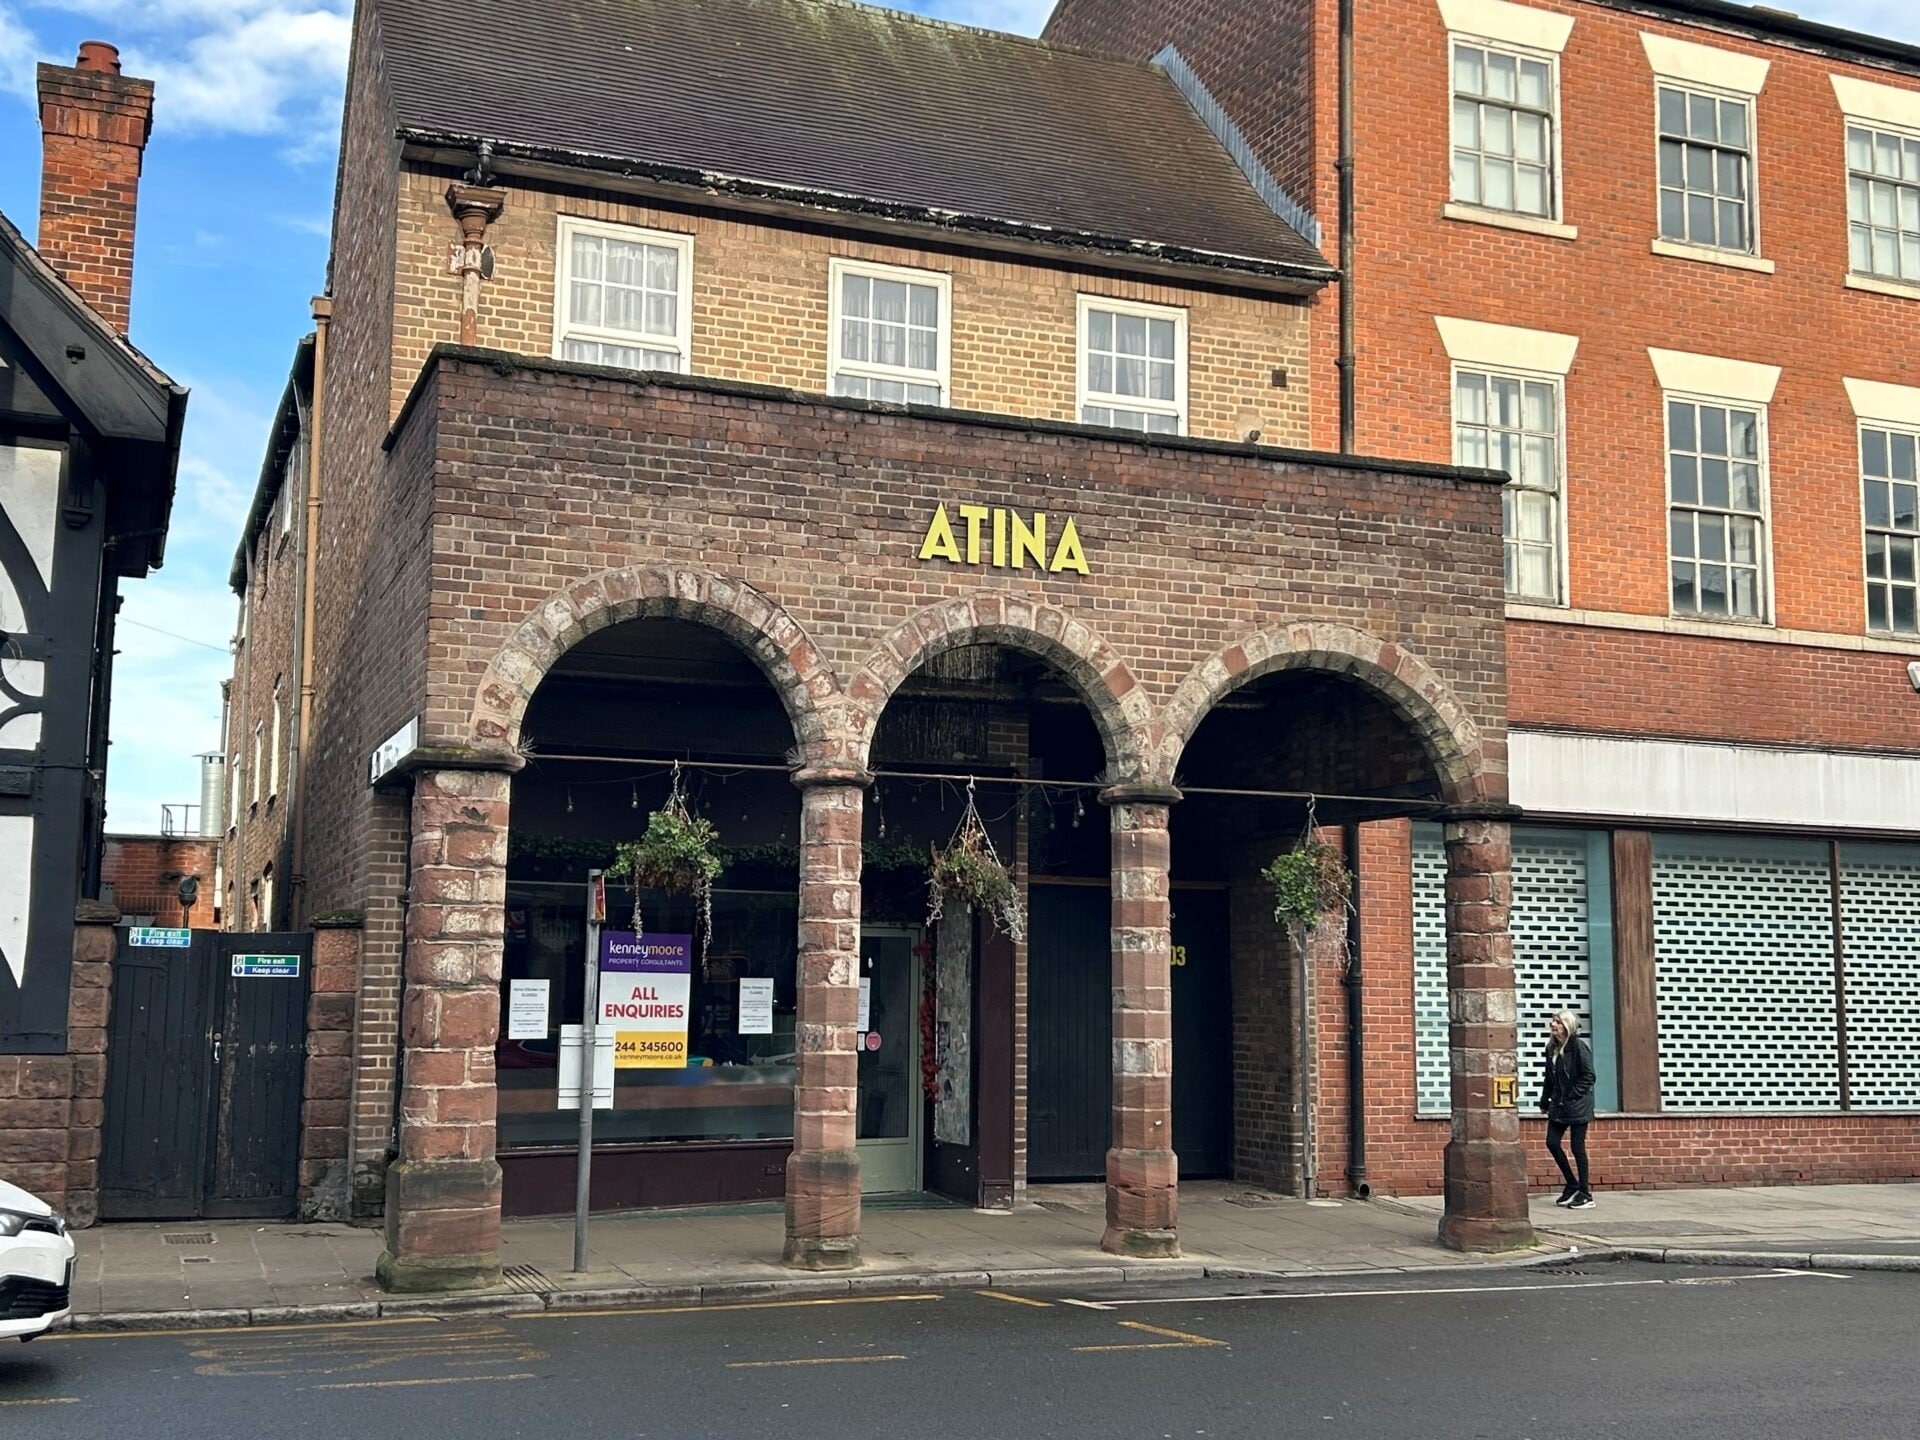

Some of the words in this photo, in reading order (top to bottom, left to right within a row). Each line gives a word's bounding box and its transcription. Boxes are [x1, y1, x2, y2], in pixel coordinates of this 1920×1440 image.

[918, 501, 1091, 575] ATINA
[149, 929, 165, 937] Fire
[609, 940, 683, 958] kenneymoore
[608, 957, 639, 966] PROPERTY
[640, 958, 683, 967] CONSULTANTS
[252, 967, 271, 975] Keep
[631, 987, 658, 1000] ALL
[605, 1004, 684, 1019] ENQUIRIES
[640, 1041, 684, 1053] 345600
[1497, 1080, 1514, 1104] H
